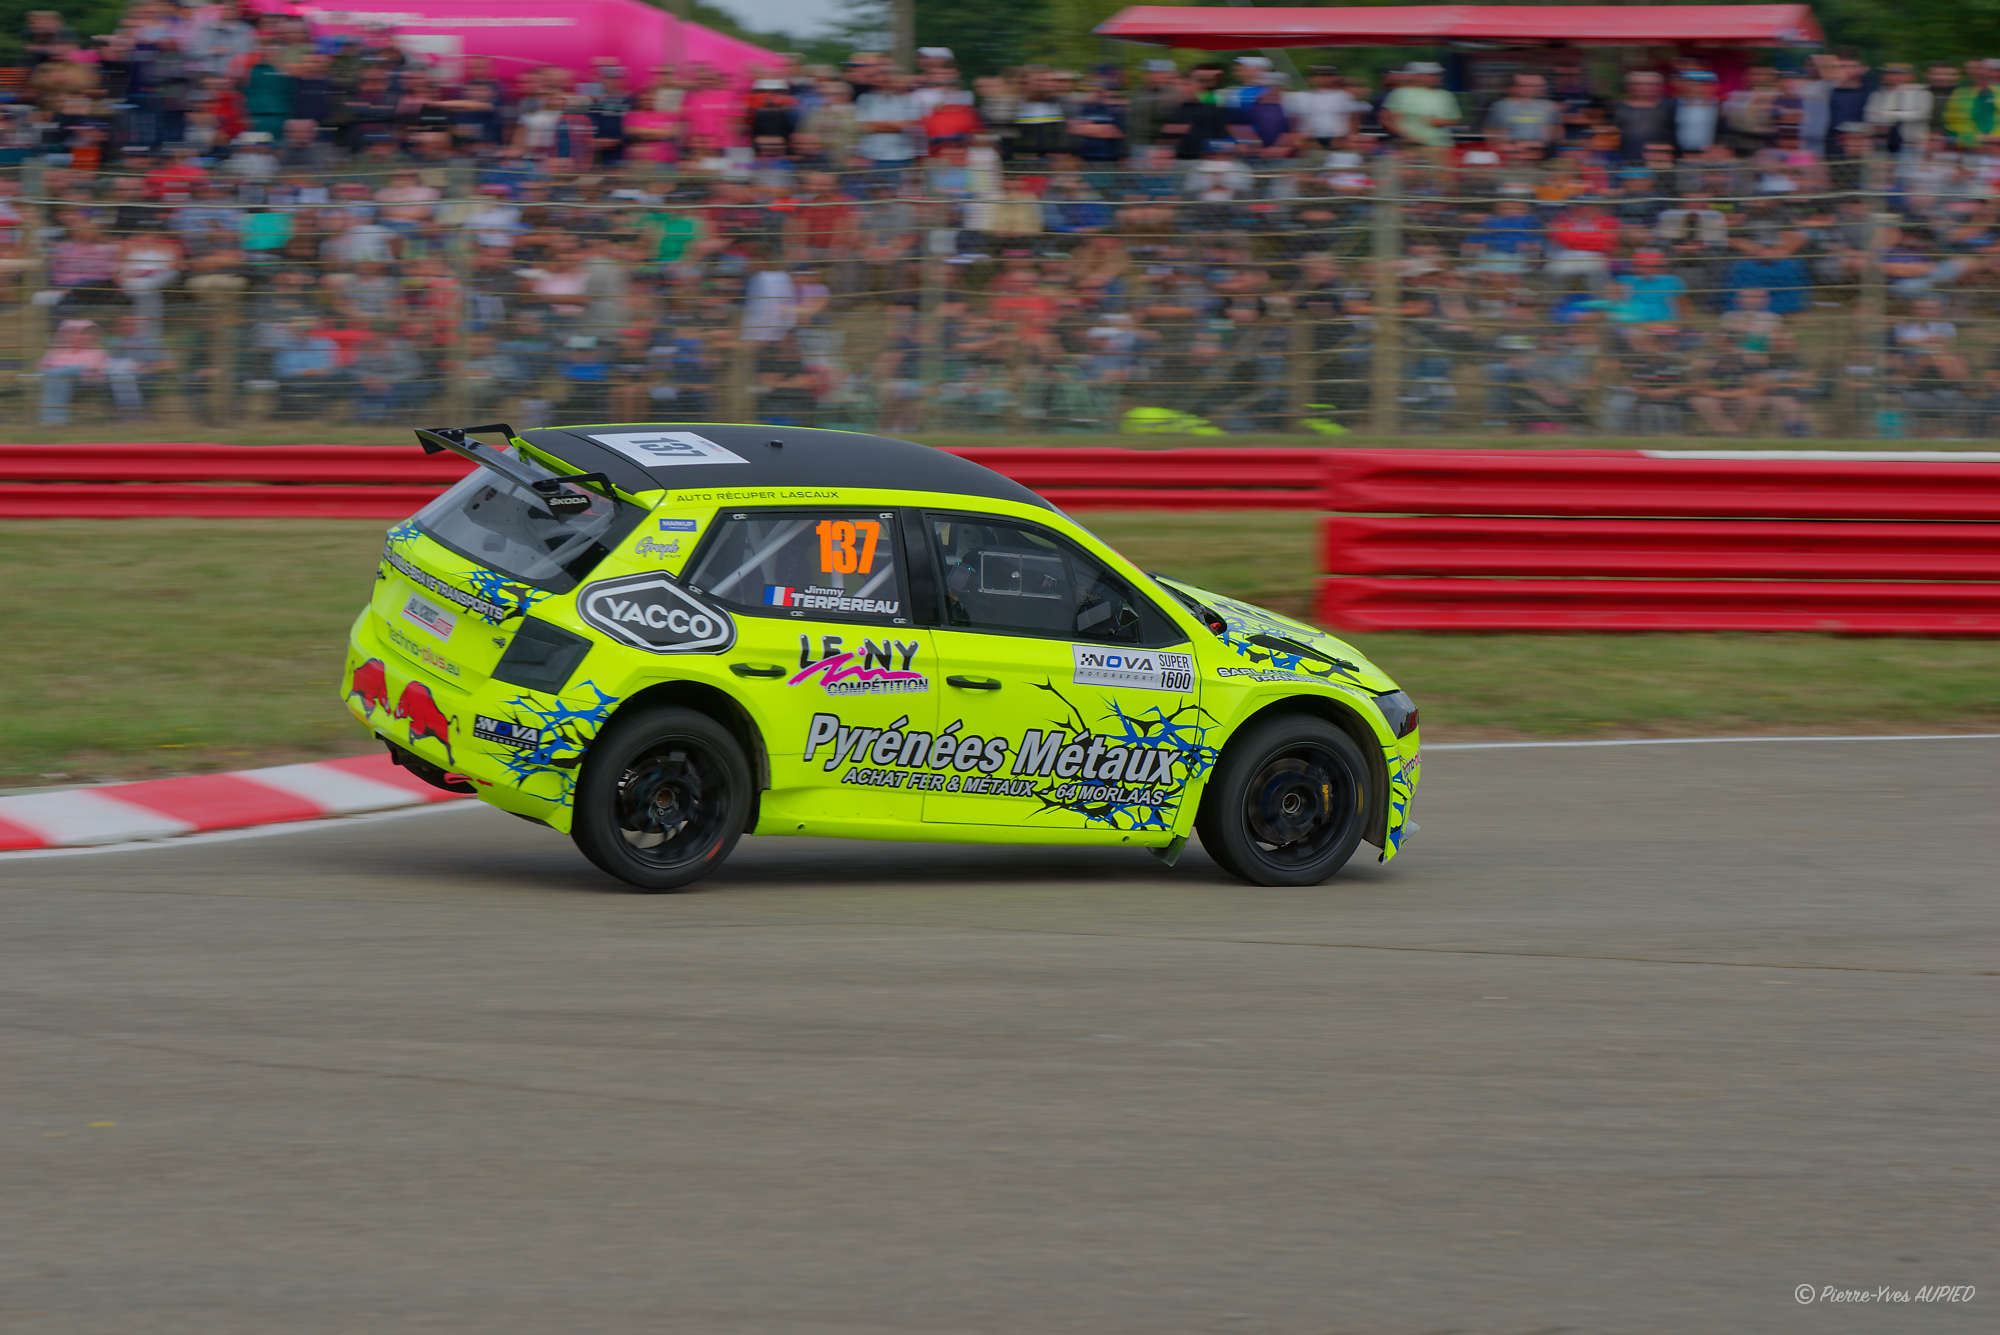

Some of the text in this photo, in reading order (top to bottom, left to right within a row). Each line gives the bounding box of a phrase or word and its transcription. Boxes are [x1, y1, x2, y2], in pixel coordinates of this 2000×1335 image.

[630, 438, 708, 456] 137
[677, 491, 839, 502] AUTO RÉCUPER LASCAUX
[815, 520, 880, 574] 137
[437, 580, 505, 620] TRANSPORTS
[804, 585, 845, 597] Jimmy
[790, 592, 899, 614] TERPEREAU
[605, 597, 713, 638] YACCO
[799, 634, 919, 671] LE NY
[1090, 653, 1153, 671] NOVA
[1158, 654, 1190, 669] SUPER
[1079, 671, 1153, 680] MOTORSPORT
[1160, 670, 1191, 690] 1600
[827, 677, 929, 696] COMPÉTITION
[480, 716, 538, 742] NOVA
[803, 712, 1182, 785] Pyrénées Métaux
[842, 767, 907, 787] ACHAT
[907, 773, 945, 791] FER
[947, 776, 960, 792] &
[963, 775, 1038, 797] MÉTAUX
[1055, 784, 1077, 800] 64
[1077, 785, 1165, 806] MORLAAS
